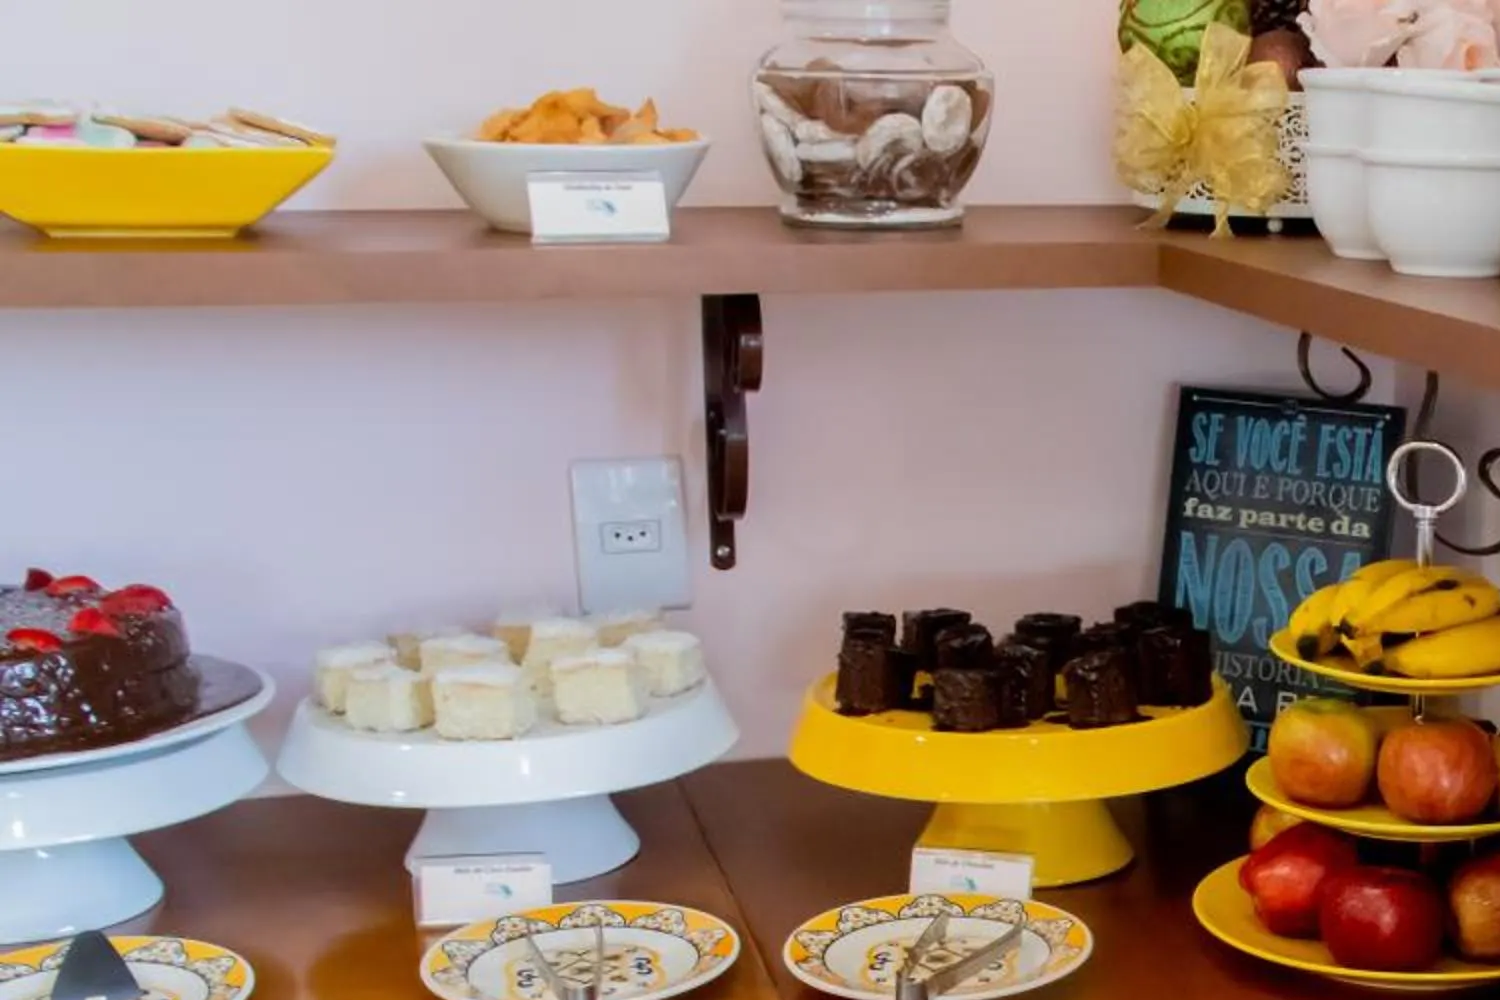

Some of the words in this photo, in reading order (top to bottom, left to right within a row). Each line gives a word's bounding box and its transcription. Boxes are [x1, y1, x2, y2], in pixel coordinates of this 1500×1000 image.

[1189, 412, 1225, 466] SE
[1236, 413, 1307, 475] VOCÊ
[1315, 420, 1385, 484] ESTÁ
[1184, 469, 1246, 500] AQUI
[1278, 475, 1381, 515] PORQUE
[1183, 497, 1233, 521] faz
[1238, 507, 1325, 532] parte
[1330, 514, 1371, 538] da
